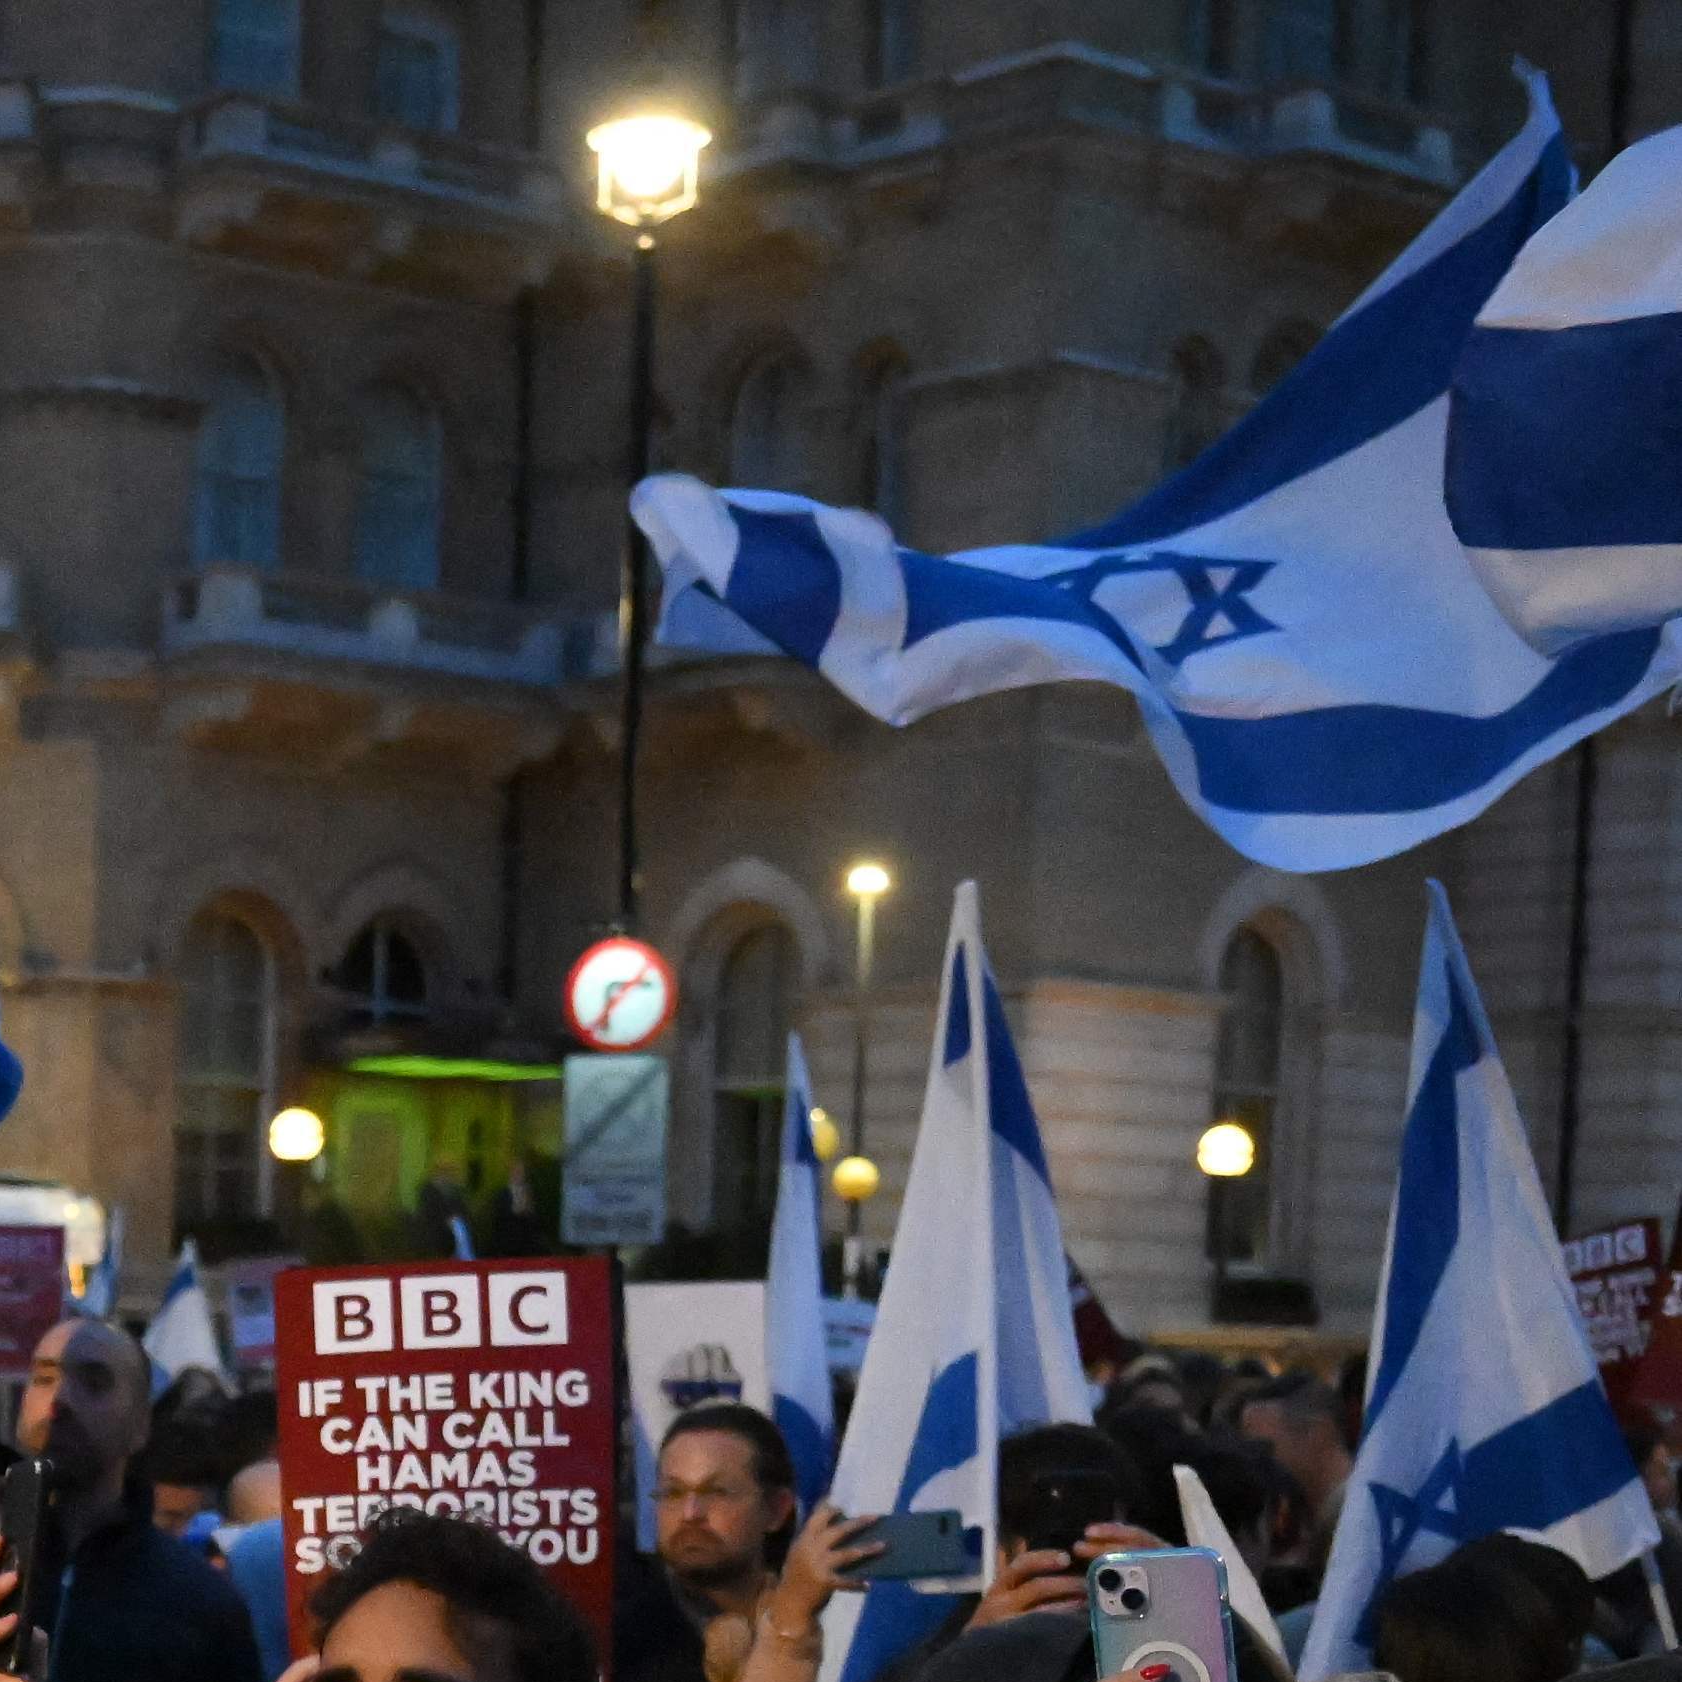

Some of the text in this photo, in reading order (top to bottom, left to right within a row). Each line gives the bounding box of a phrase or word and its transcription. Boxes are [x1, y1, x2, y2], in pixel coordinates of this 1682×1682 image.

[334, 1285, 550, 1343] BBC
[298, 1369, 590, 1418] IF THE KING
[320, 1409, 570, 1454] CAN CALL
[356, 1450, 538, 1491] HAMAS
[295, 1532, 363, 1574] SO
